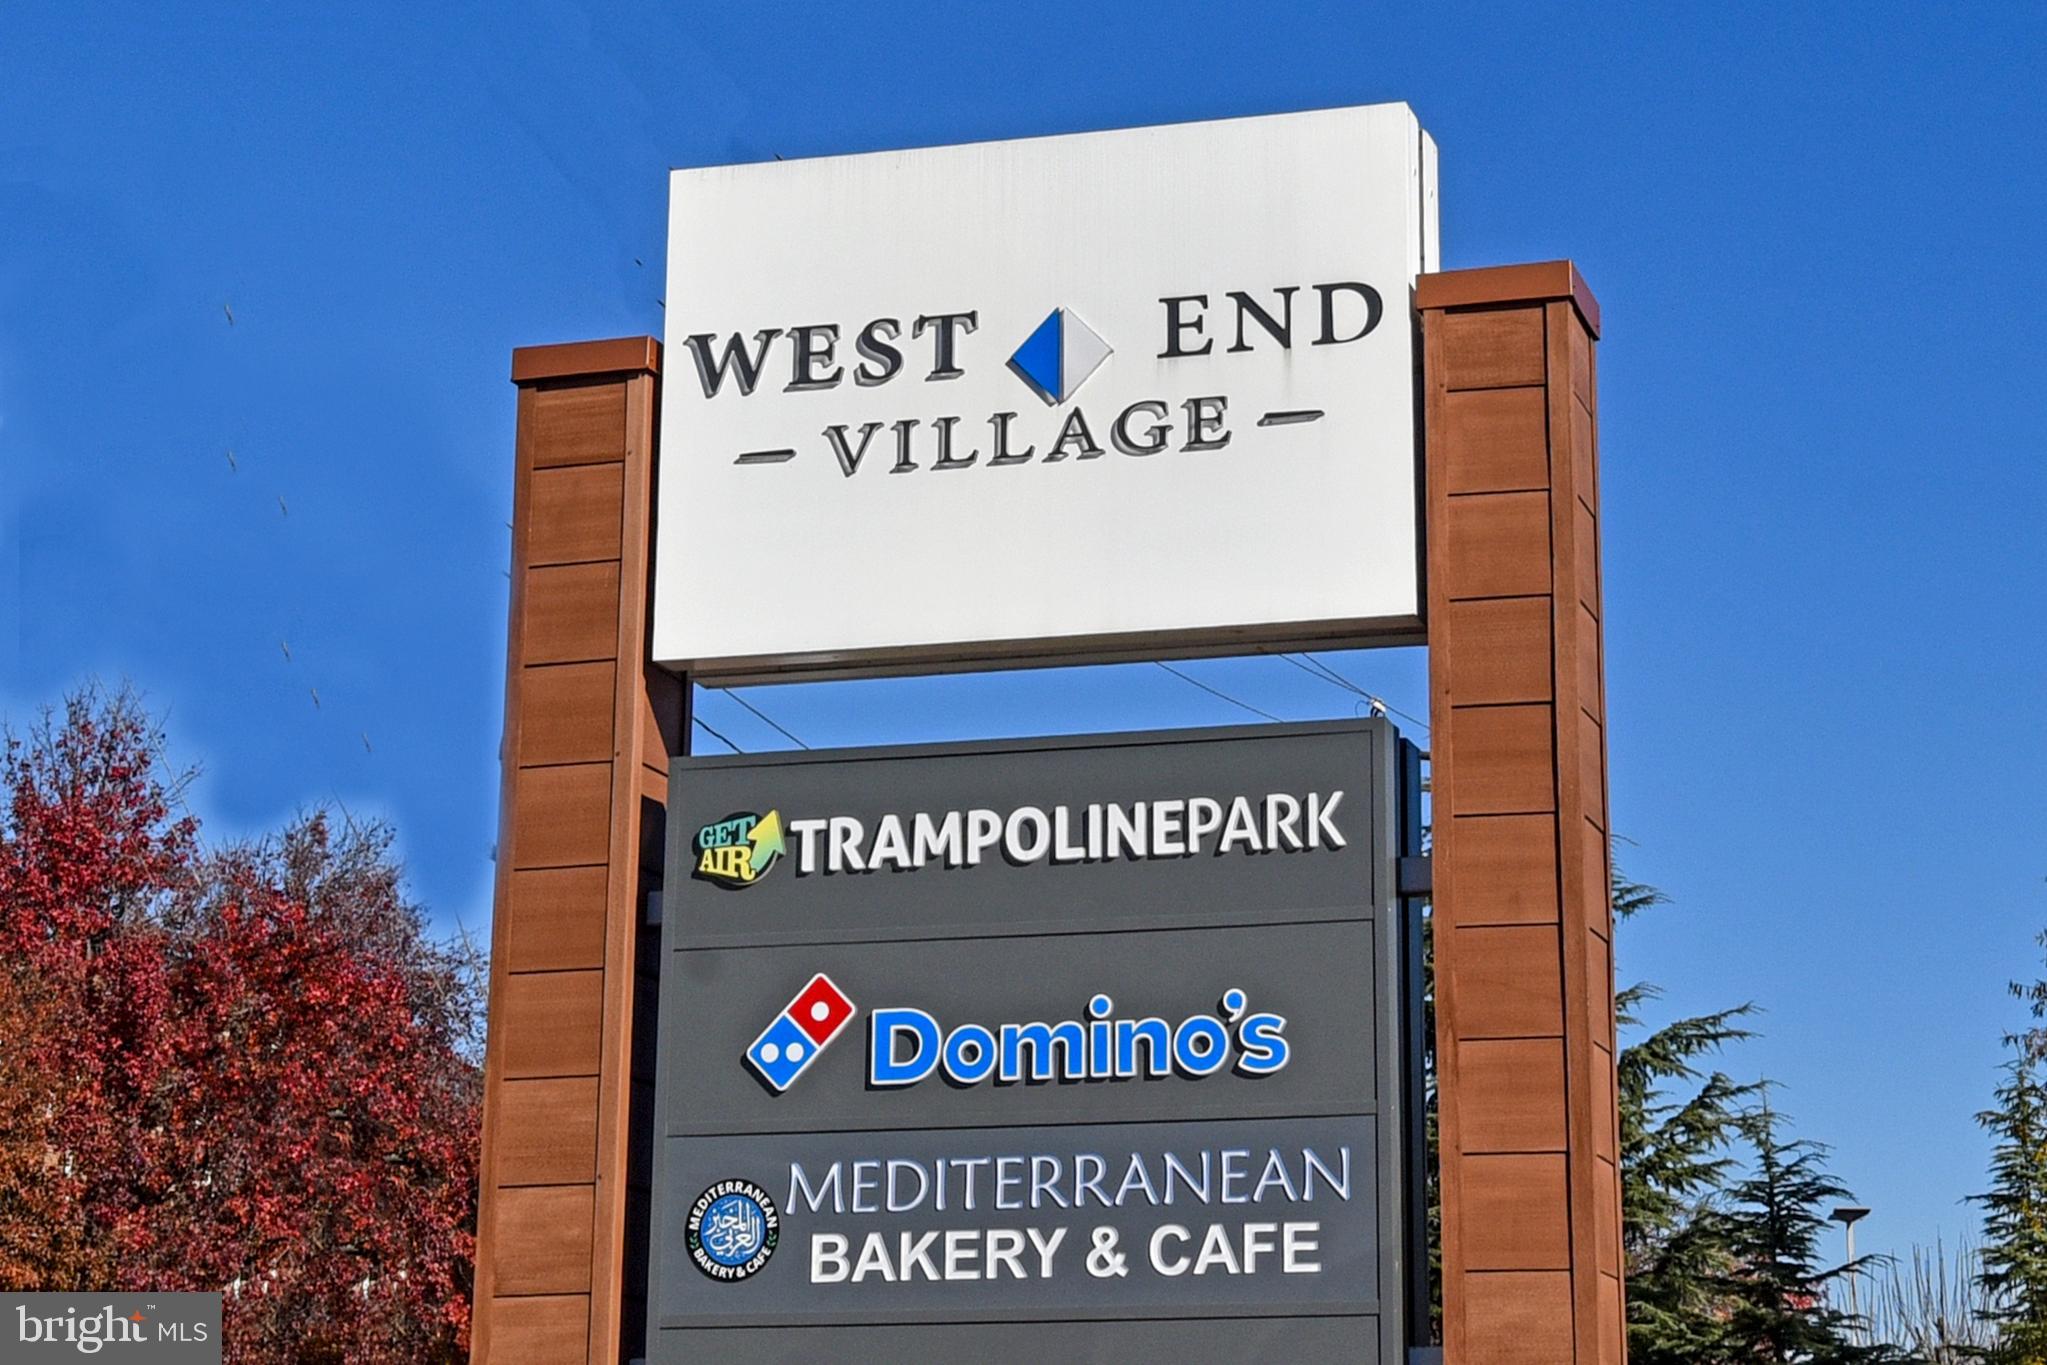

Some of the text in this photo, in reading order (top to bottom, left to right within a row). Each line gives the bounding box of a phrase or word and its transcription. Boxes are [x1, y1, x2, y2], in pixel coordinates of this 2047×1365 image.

[683, 281, 1385, 399] WEST END
[822, 395, 1233, 477] VILLAGE
[698, 845, 756, 881] AIR
[699, 815, 756, 849] GET
[790, 790, 1347, 875] TRAMPOLINEPARK
[870, 988, 1290, 1086] Domino's
[688, 1181, 778, 1231] MEDITERRANEAN
[785, 1146, 1351, 1215] MEDITERRANEAN
[693, 1246, 772, 1279] BAKERY & CAFE
[809, 1221, 1322, 1284] BAKERY & CAFE
